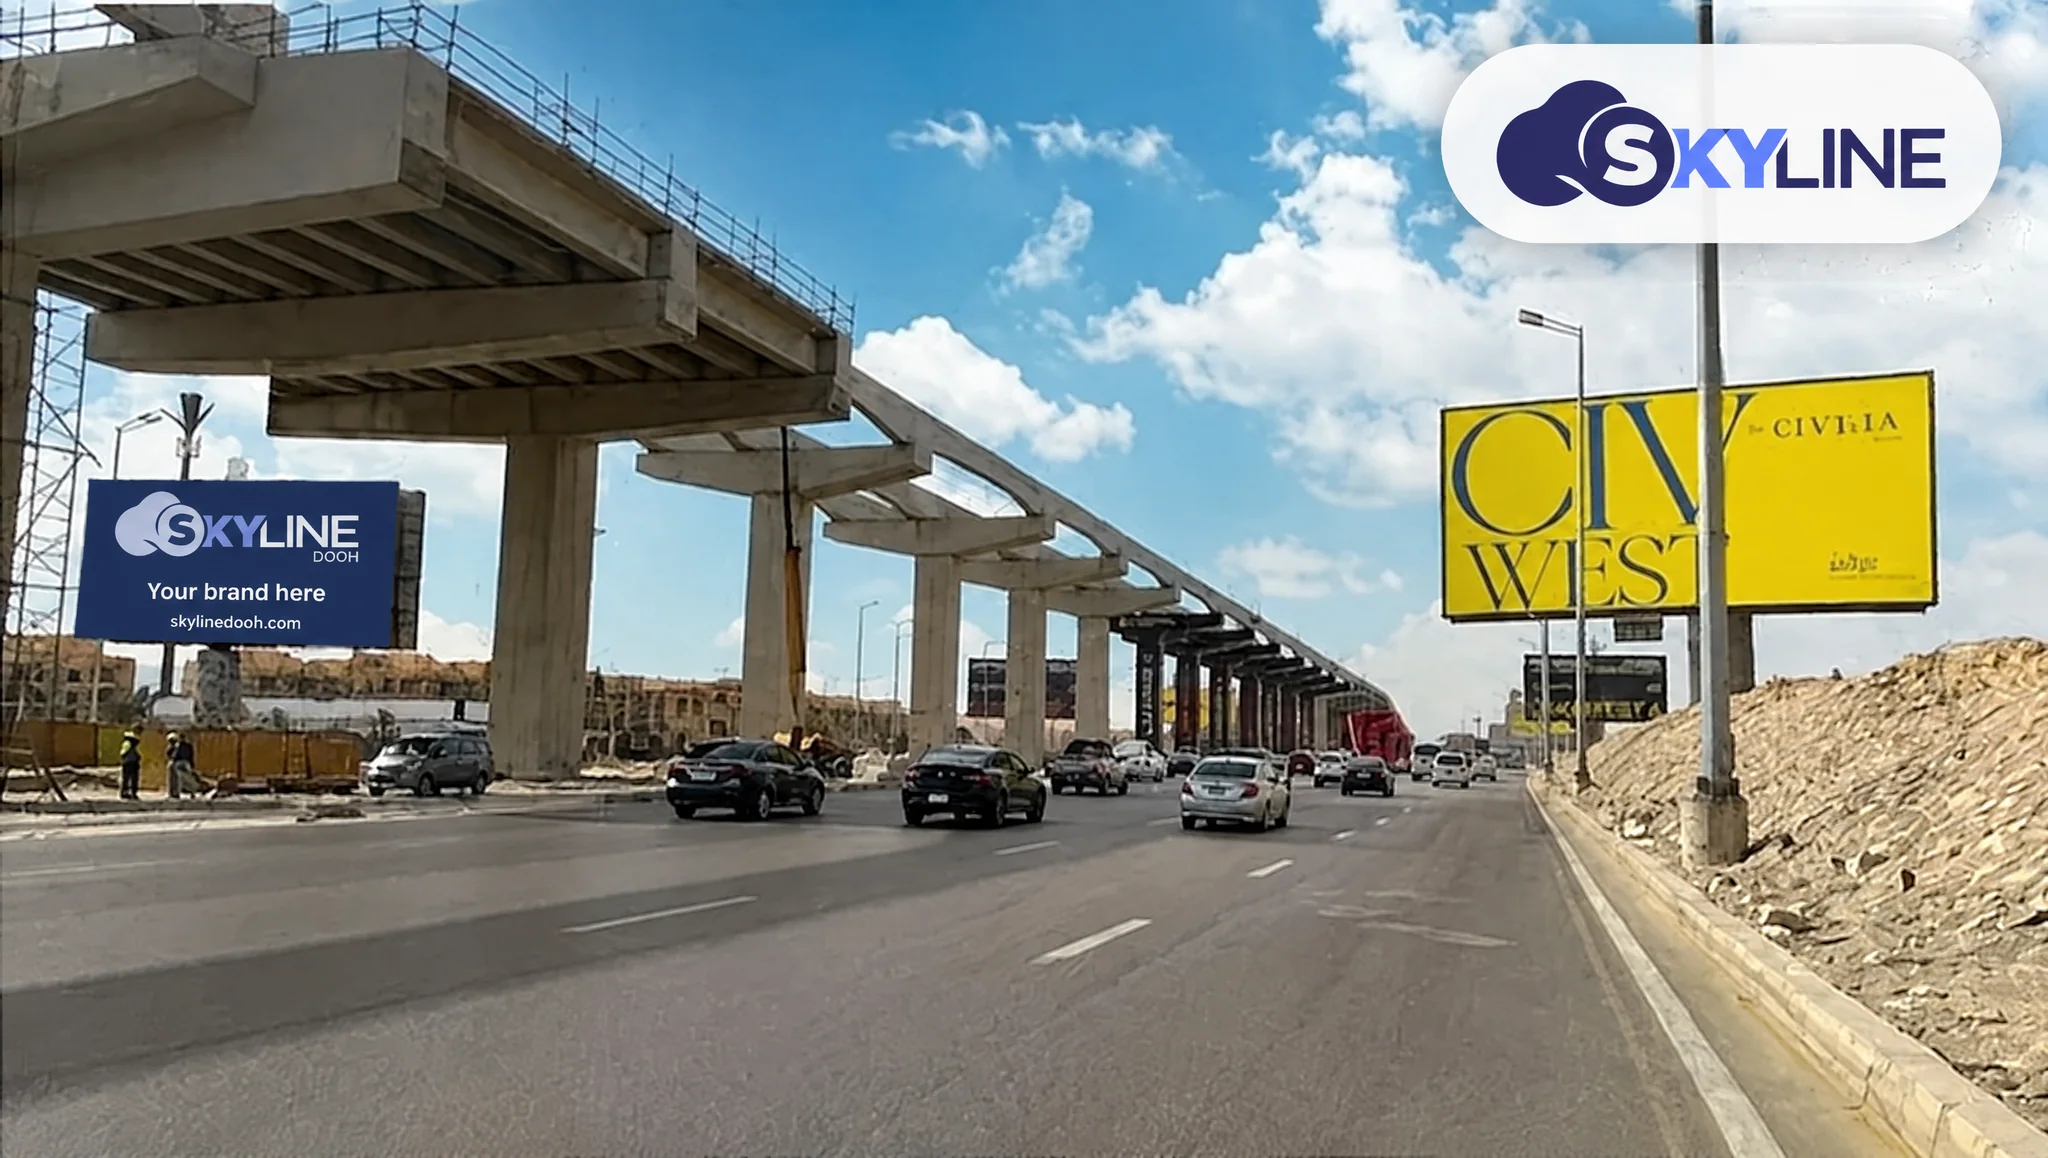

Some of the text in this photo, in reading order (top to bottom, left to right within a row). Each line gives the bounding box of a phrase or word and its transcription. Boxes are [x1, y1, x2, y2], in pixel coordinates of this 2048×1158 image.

[167, 512, 360, 549] SKYLINE
[312, 550, 360, 563] DOOH
[147, 582, 326, 602] Your brand here
[169, 614, 302, 632] skylinedooh.com
